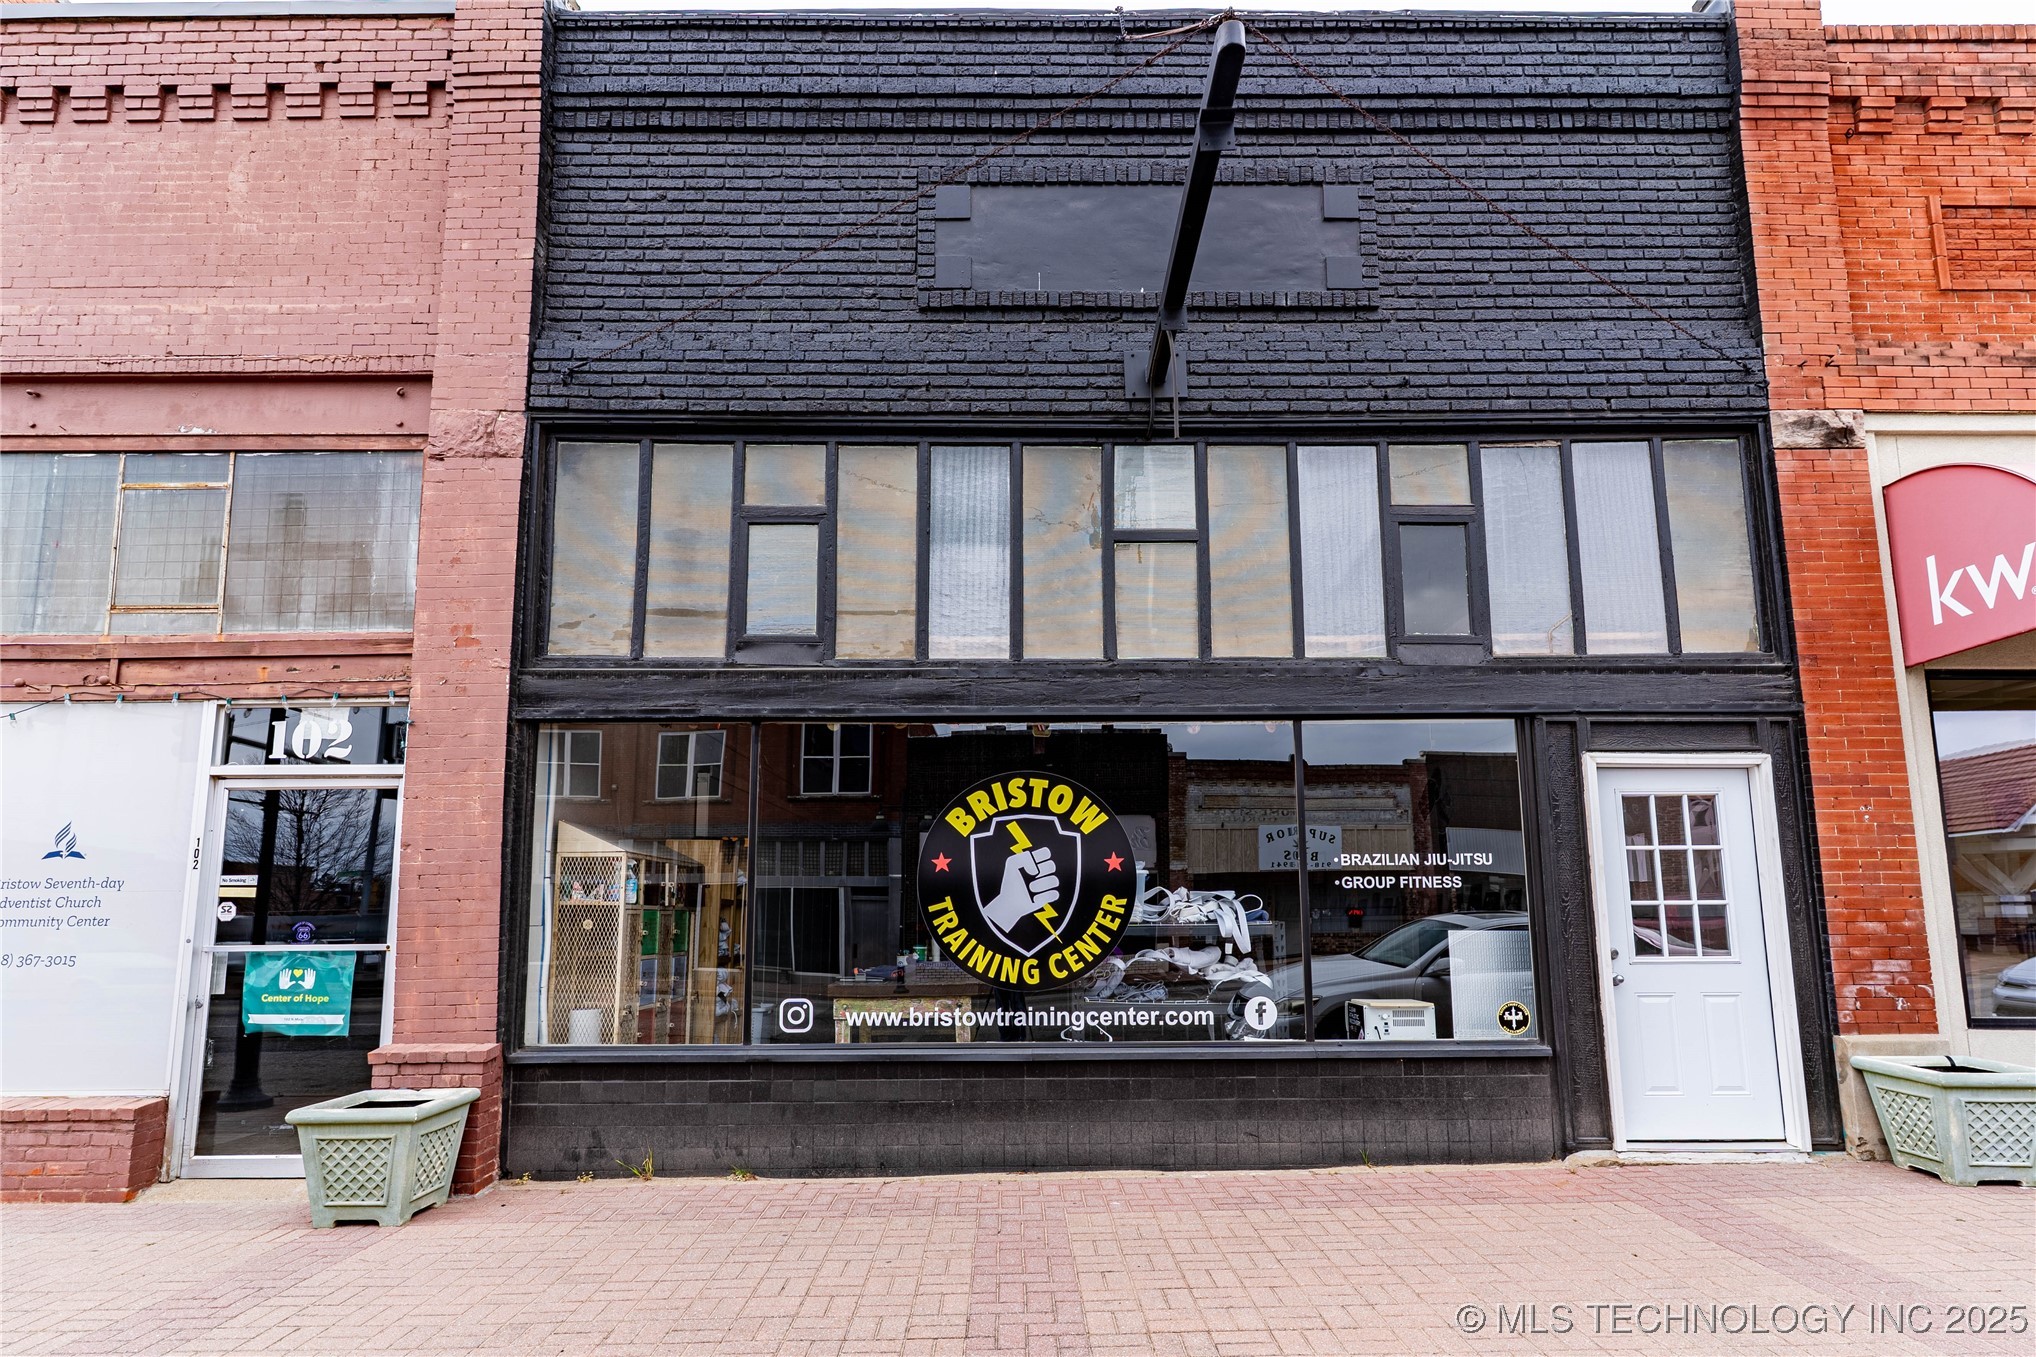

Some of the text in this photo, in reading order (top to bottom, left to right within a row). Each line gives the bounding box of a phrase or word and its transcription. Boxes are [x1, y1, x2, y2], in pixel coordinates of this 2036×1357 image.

[1926, 541, 2036, 625] kw
[268, 720, 353, 759] 102
[945, 778, 1109, 837] BRISTOW
[193, 837, 201, 870] 102
[1340, 853, 1493, 867] BRAZILIAN JIU-JITSU
[1, 877, 125, 892] ristow Seventh-day
[1341, 875, 1463, 889] GROUP FITNESS
[0, 896, 102, 909] dventist Church
[0, 915, 111, 930] ommunity Center
[298, 931, 309, 939] 66
[928, 894, 1128, 985] TRAINING CENTER
[0, 953, 77, 968] 8) 367-3015
[261, 993, 330, 1004] Center of Hope
[846, 1007, 1215, 1031] www.bristowtrainingcenter.com
